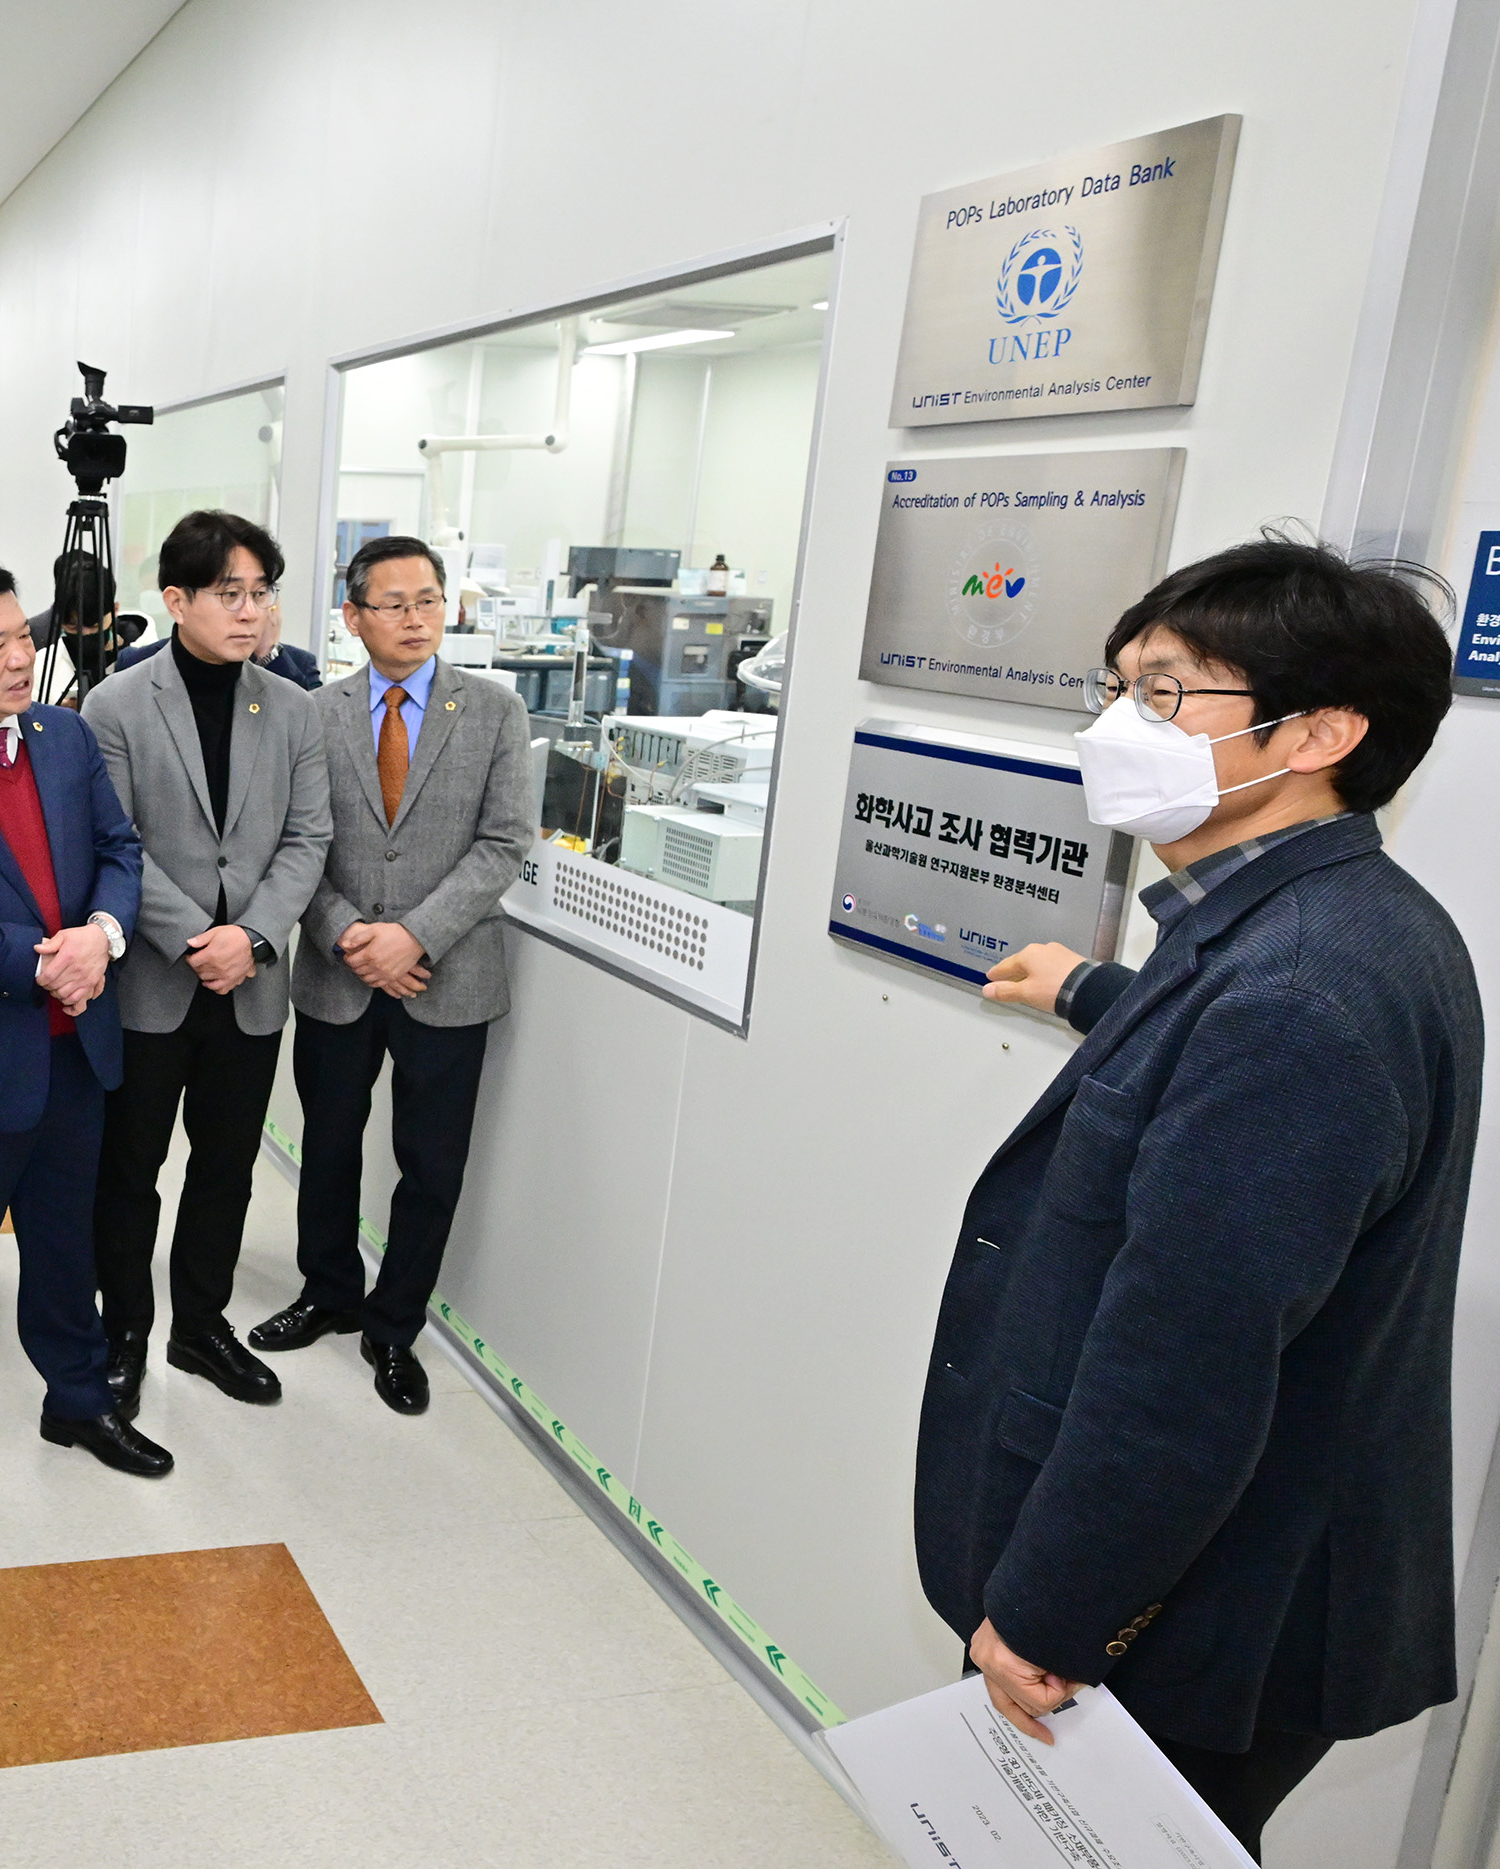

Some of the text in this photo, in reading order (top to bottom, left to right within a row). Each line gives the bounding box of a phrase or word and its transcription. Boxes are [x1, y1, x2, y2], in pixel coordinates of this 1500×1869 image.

[946, 156, 1176, 229] POPs Laboratory Data Bank
[988, 327, 1072, 365] UNEP
[964, 383, 1044, 404] Environmental
[1047, 379, 1100, 397] Analysis
[1105, 374, 1152, 391] Center
[890, 470, 914, 481] No.13
[892, 489, 1146, 509] Accreditation of POPs Sampling & Analysis
[928, 658, 1003, 679] Environmental
[1005, 667, 1055, 685] Analysis
[1468, 650, 1500, 666] Anal
[855, 793, 1089, 877] 화학사고 조사 협력기관
[865, 838, 1060, 904] 울산과학기술원 연구지원본부 환경분석센터
